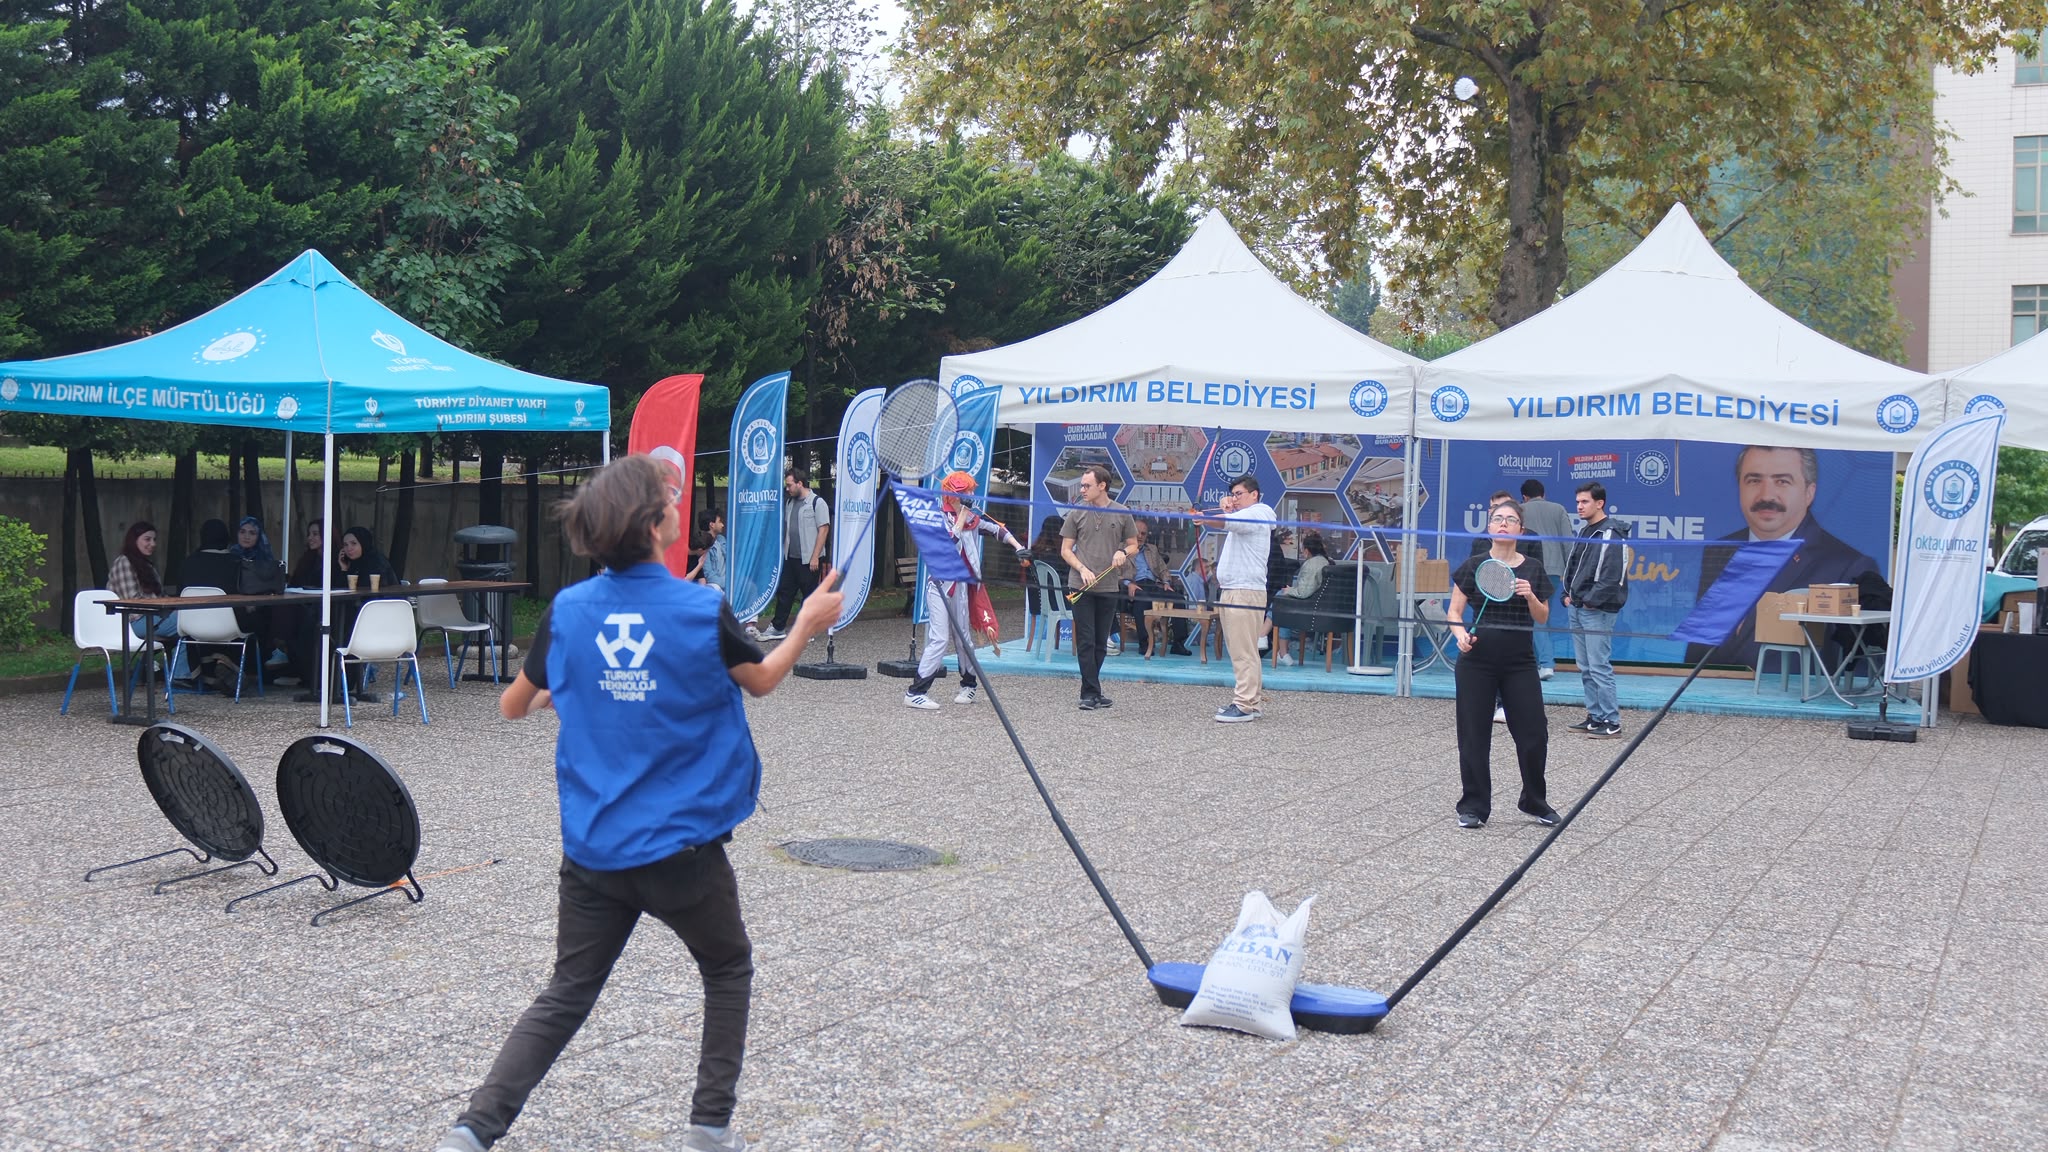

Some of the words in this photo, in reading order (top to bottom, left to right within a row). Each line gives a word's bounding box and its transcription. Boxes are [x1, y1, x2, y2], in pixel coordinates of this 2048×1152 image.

[30, 382, 102, 403] YILDIRIM
[107, 382, 147, 409] İLÇE
[152, 386, 266, 415] MÜFTÜLÜĞÜ
[1018, 381, 1138, 405] YILDIRIM
[1147, 380, 1315, 410] BELEDİYESİ
[415, 396, 465, 409] TÜRKİYE
[468, 395, 514, 408] DİYANET
[516, 398, 547, 409] VAKFI
[1506, 393, 1640, 418] YILDIRIM
[1652, 392, 1840, 426] BELEDİYESİ
[436, 413, 486, 425] YILDIRIM
[489, 412, 527, 425] ŞUBESİ
[1067, 423, 1104, 434] DURMADAN
[1064, 431, 1107, 442] YORULMADAN
[1573, 461, 1612, 471] DURMADAN
[1570, 469, 1616, 480] YORULMADAN
[1899, 623, 1971, 675] www.yildirim.bel.tr
